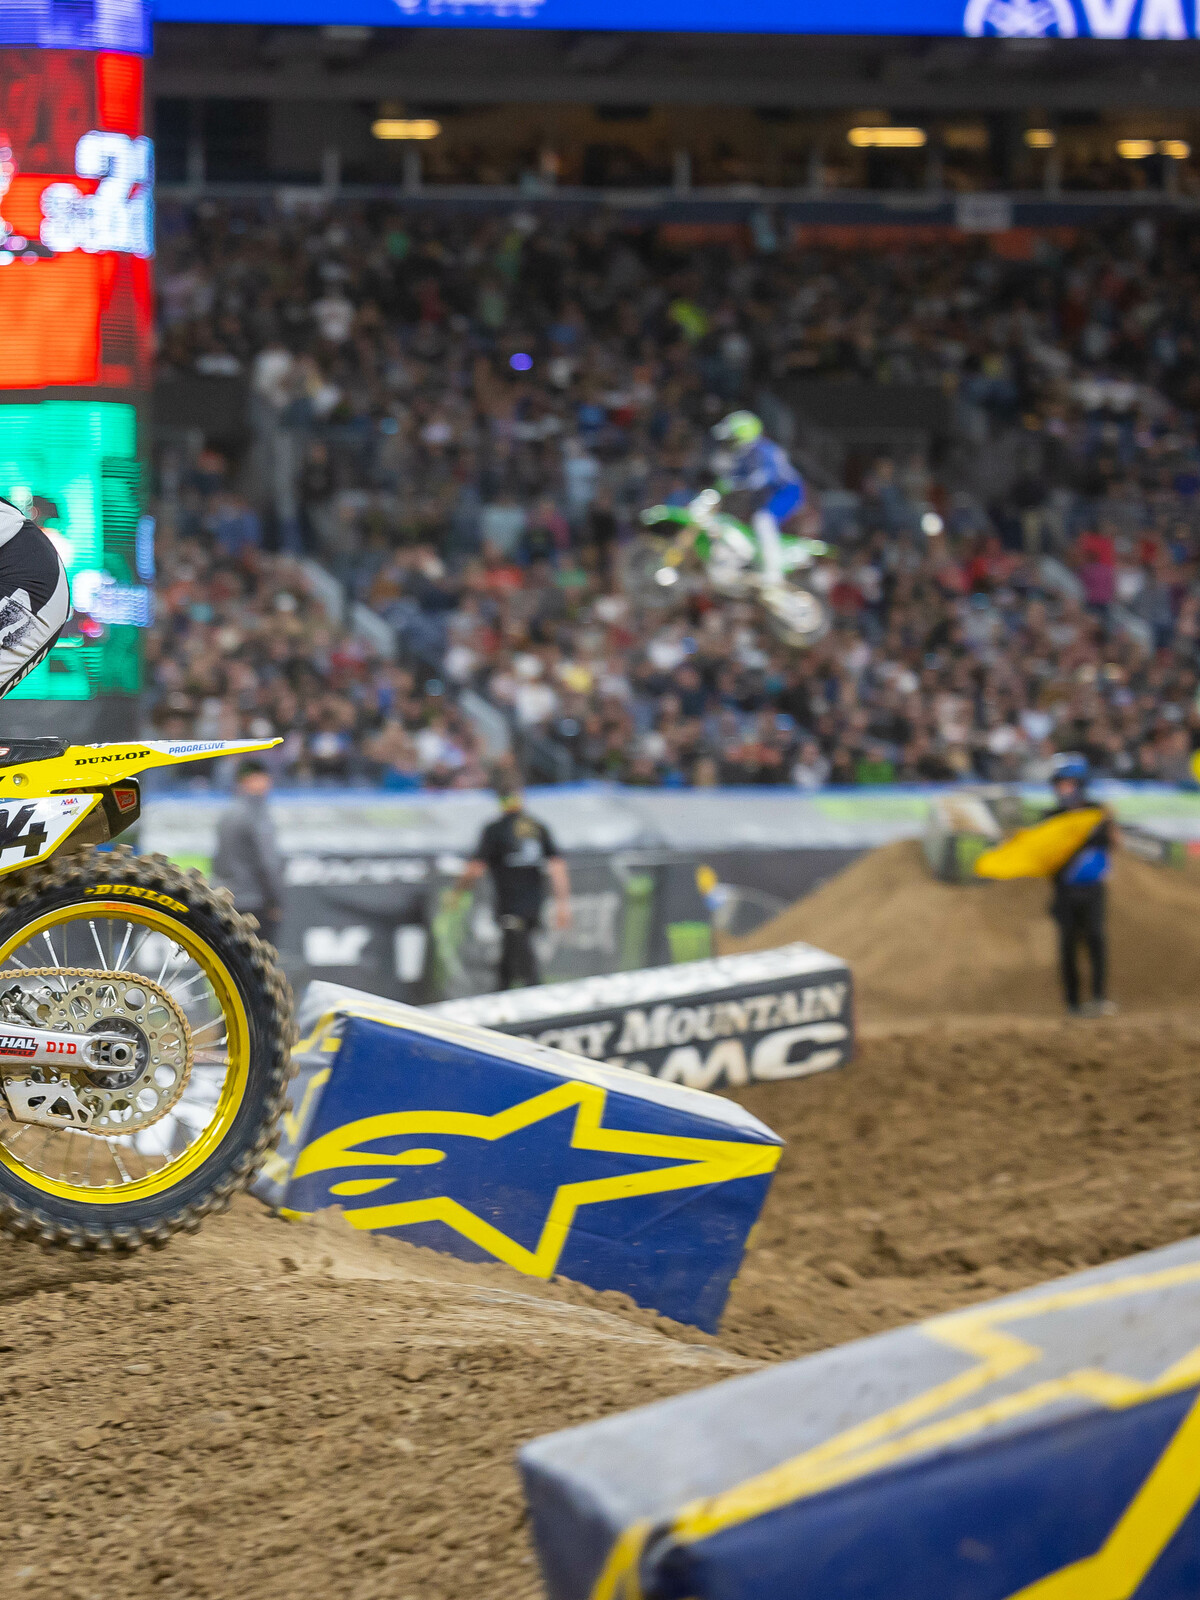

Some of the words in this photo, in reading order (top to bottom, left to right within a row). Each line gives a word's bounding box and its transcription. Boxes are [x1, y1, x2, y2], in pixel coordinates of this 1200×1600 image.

[168, 742, 226, 754] PROGRESSIVE
[75, 750, 151, 766] DUNLOP
[94, 884, 190, 914] DUNLOP
[615, 982, 848, 1054] MOUNTAIN
[46, 1041, 77, 1054] DID
